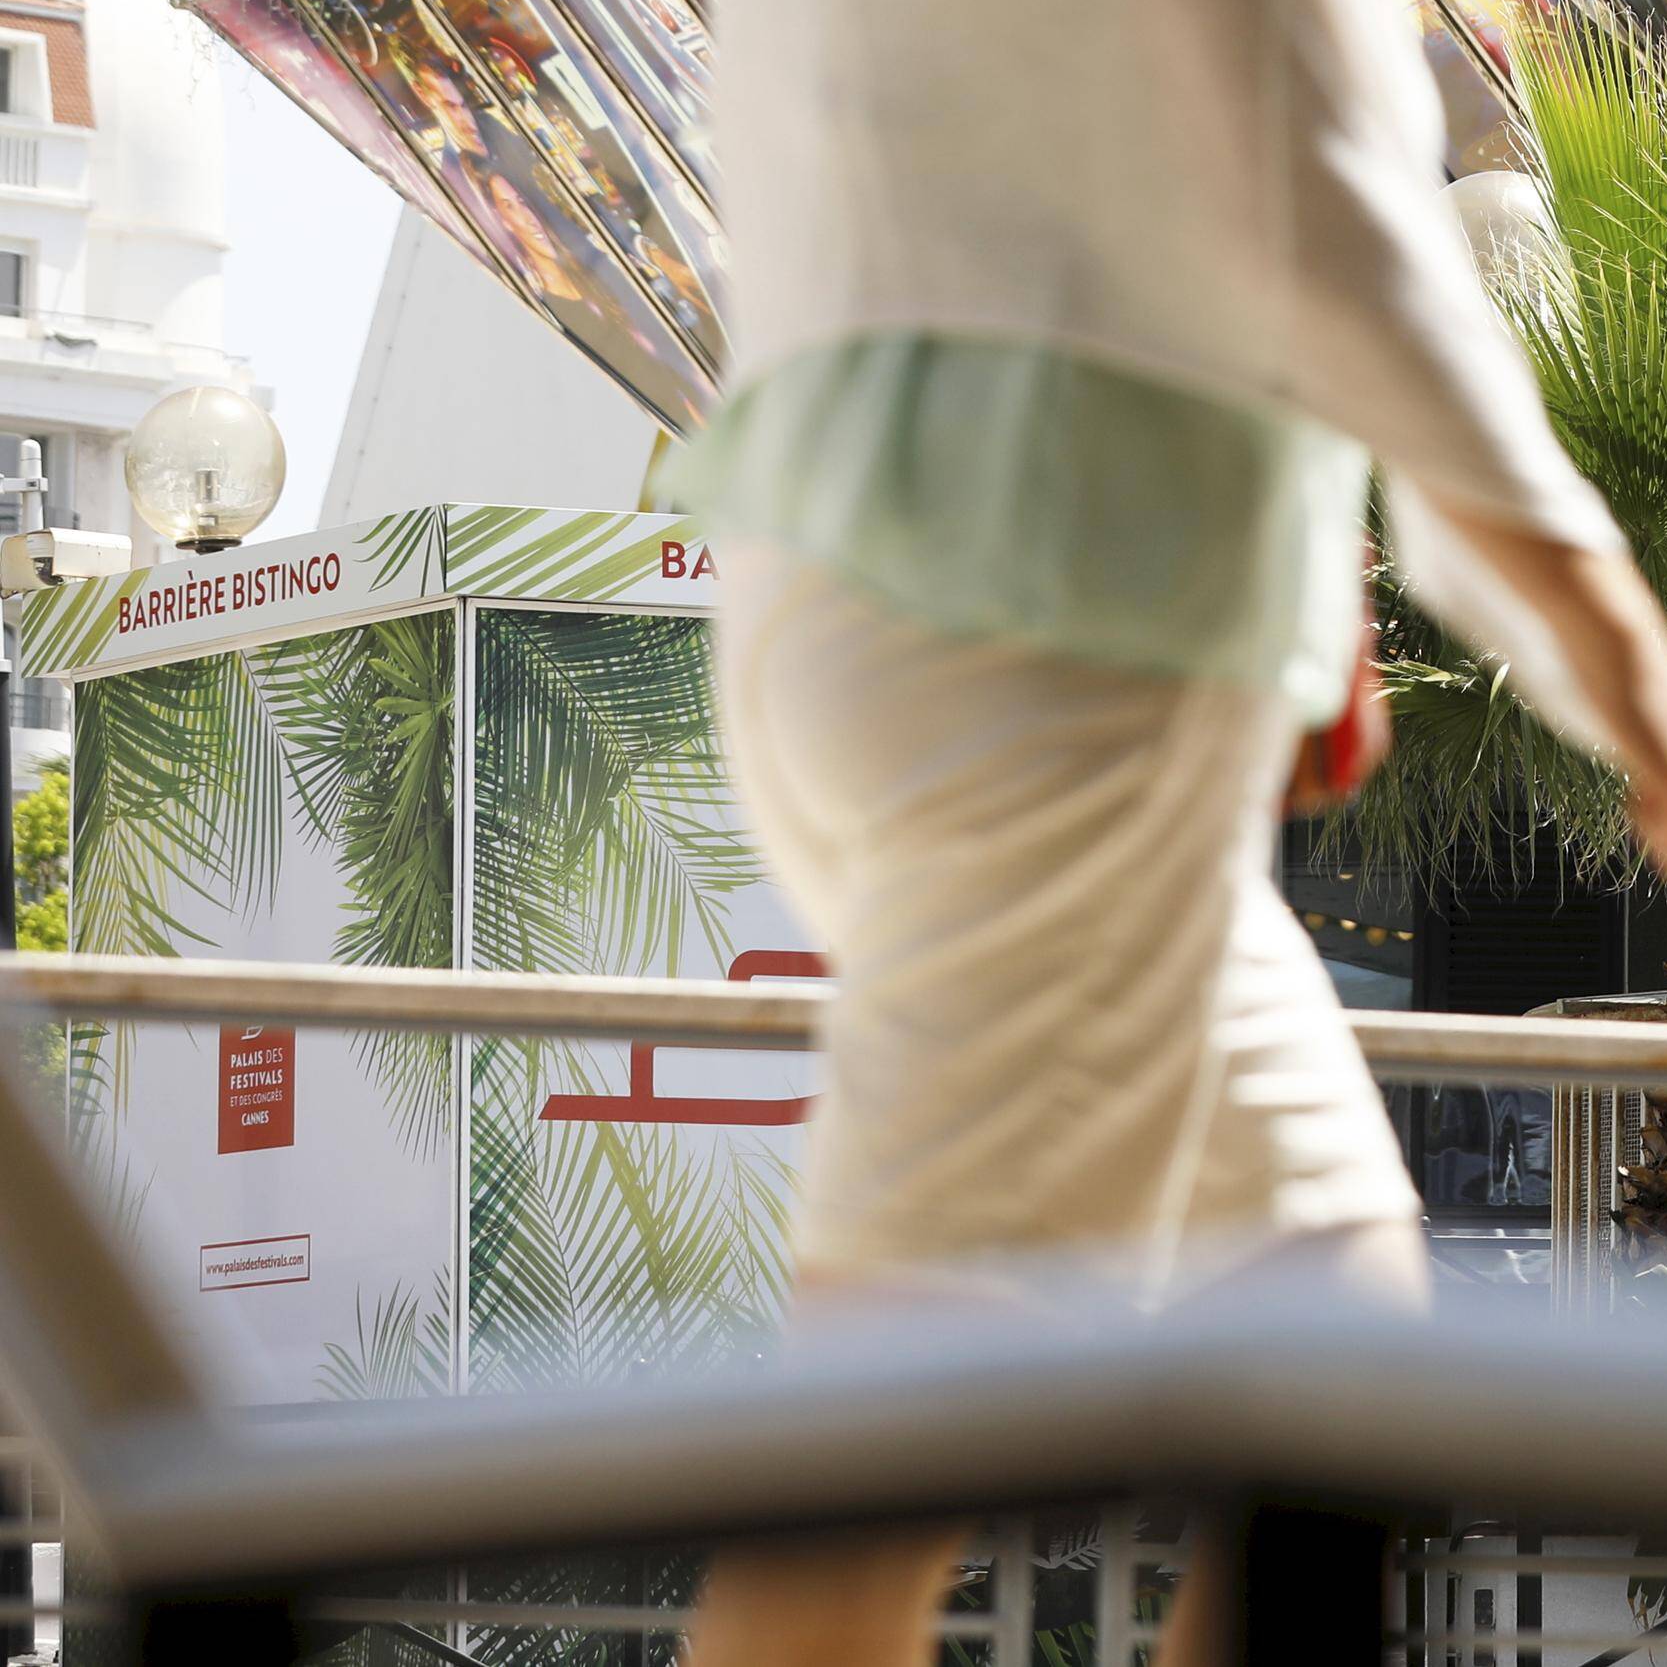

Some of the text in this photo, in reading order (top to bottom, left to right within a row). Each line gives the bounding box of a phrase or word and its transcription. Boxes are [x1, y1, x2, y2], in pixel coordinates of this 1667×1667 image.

[118, 552, 341, 634] BARRIÈRE BISTINGO
[231, 1047, 284, 1069] PALAIS DES
[230, 1069, 283, 1090] FESTIVALS
[230, 1088, 283, 1107] ET DES CONGRÈS
[241, 1110, 269, 1126] CANNES
[205, 1254, 305, 1277] www.palaisdesfestivals.com
